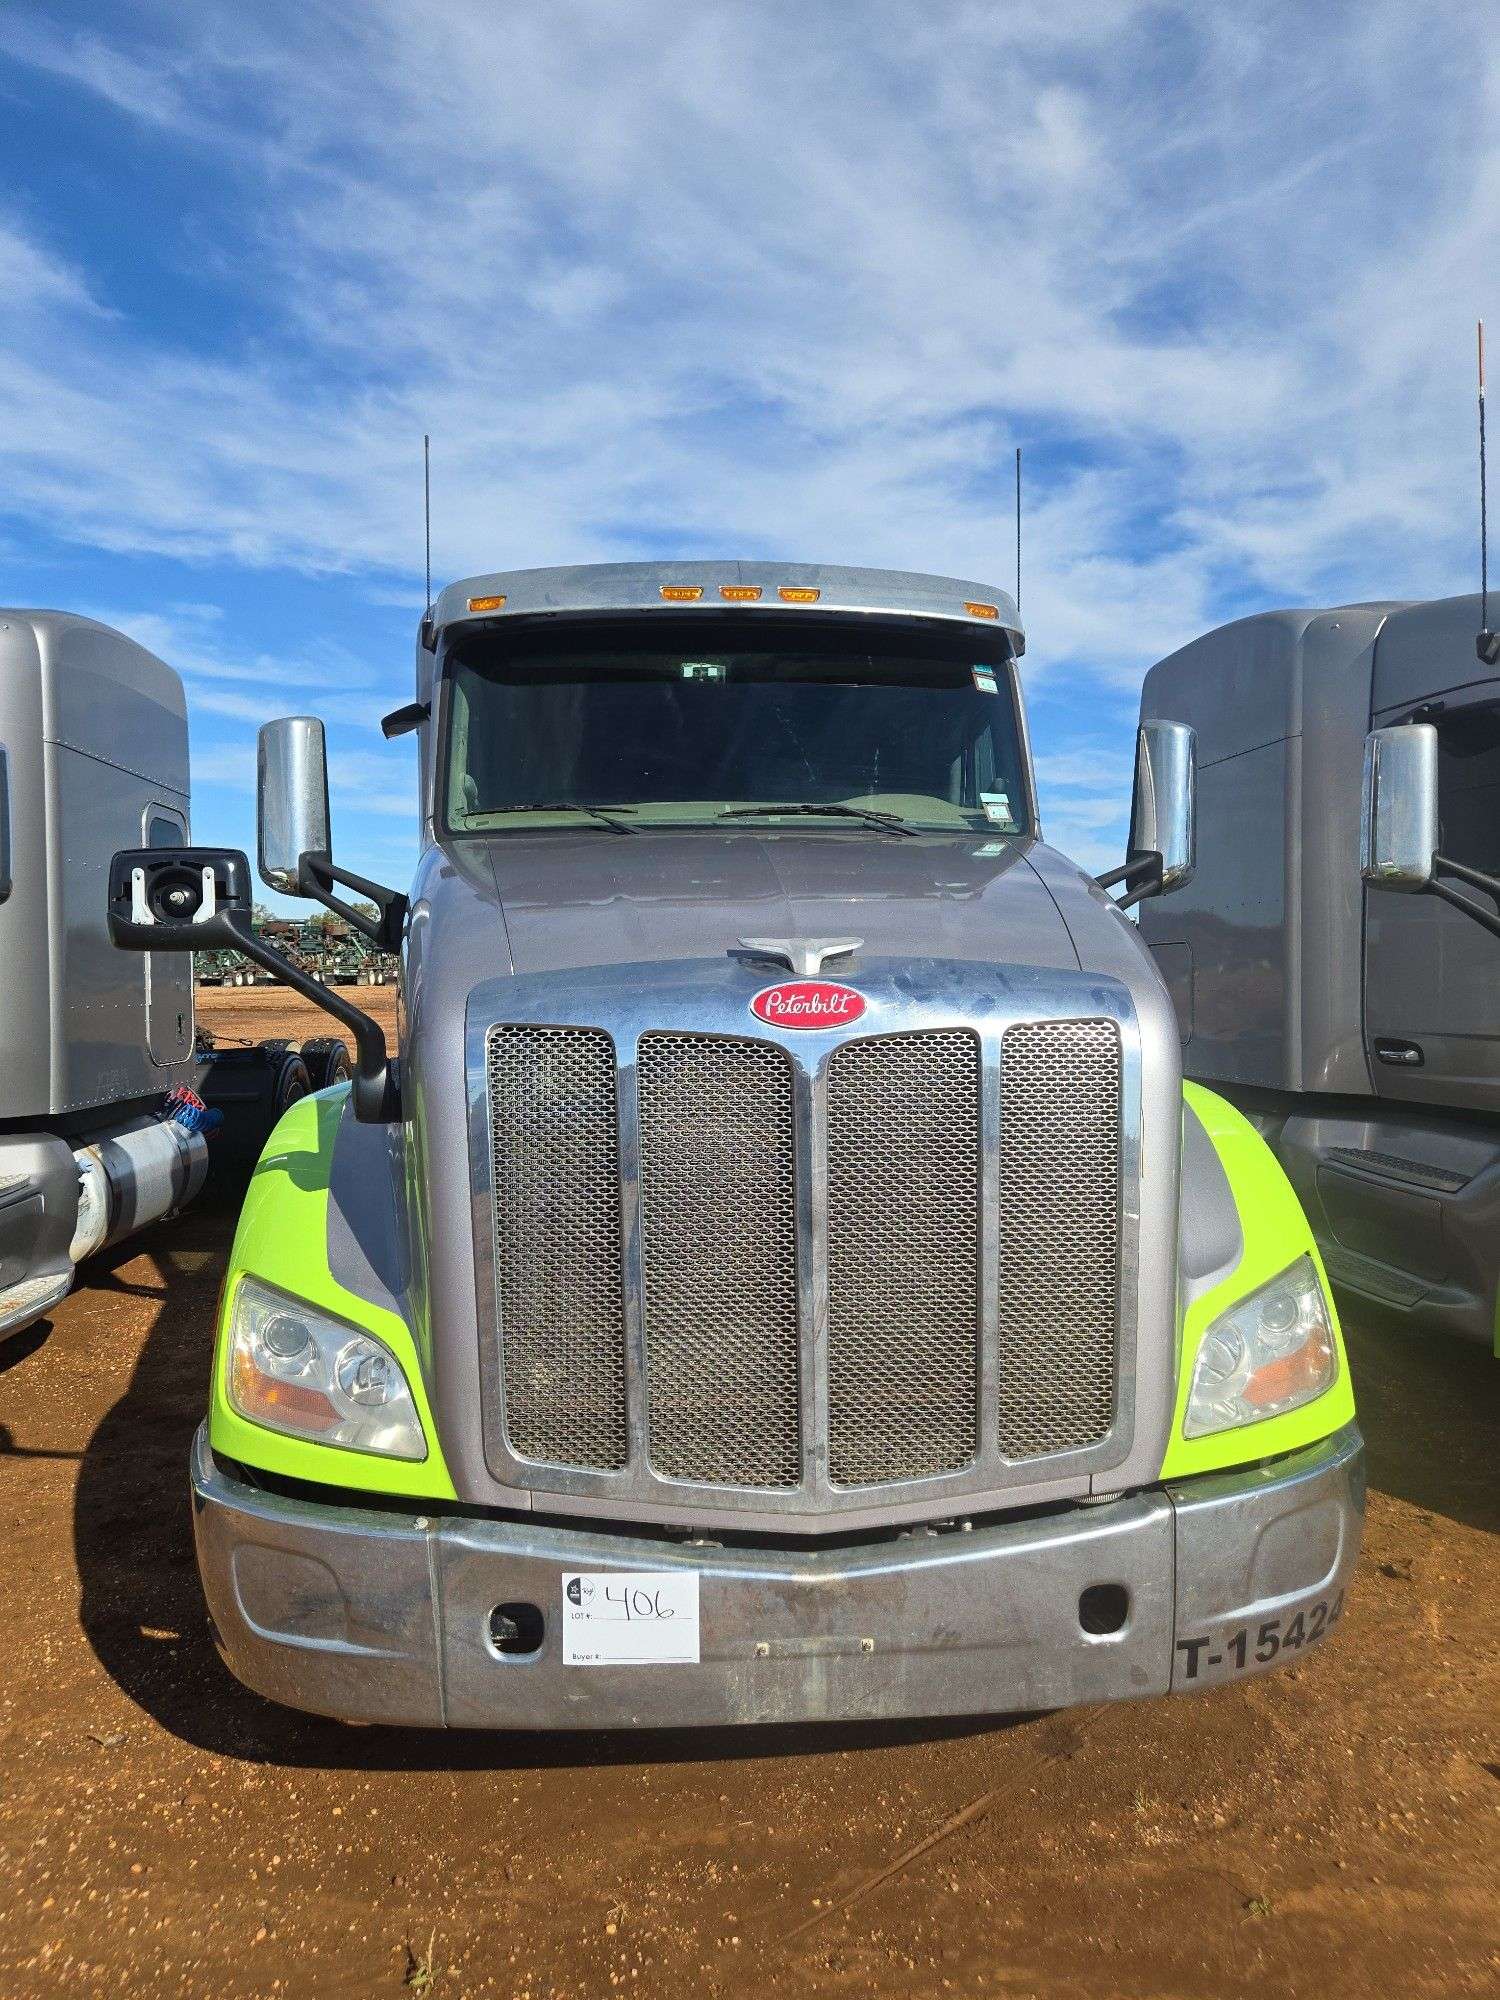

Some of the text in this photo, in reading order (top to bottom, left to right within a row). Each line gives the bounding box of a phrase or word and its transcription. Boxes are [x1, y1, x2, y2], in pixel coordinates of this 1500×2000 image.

[765, 991, 857, 1017] Peterbilt
[605, 1586, 675, 1621] 406
[571, 1612, 586, 1620] LOT
[572, 1653, 593, 1662] Buyer
